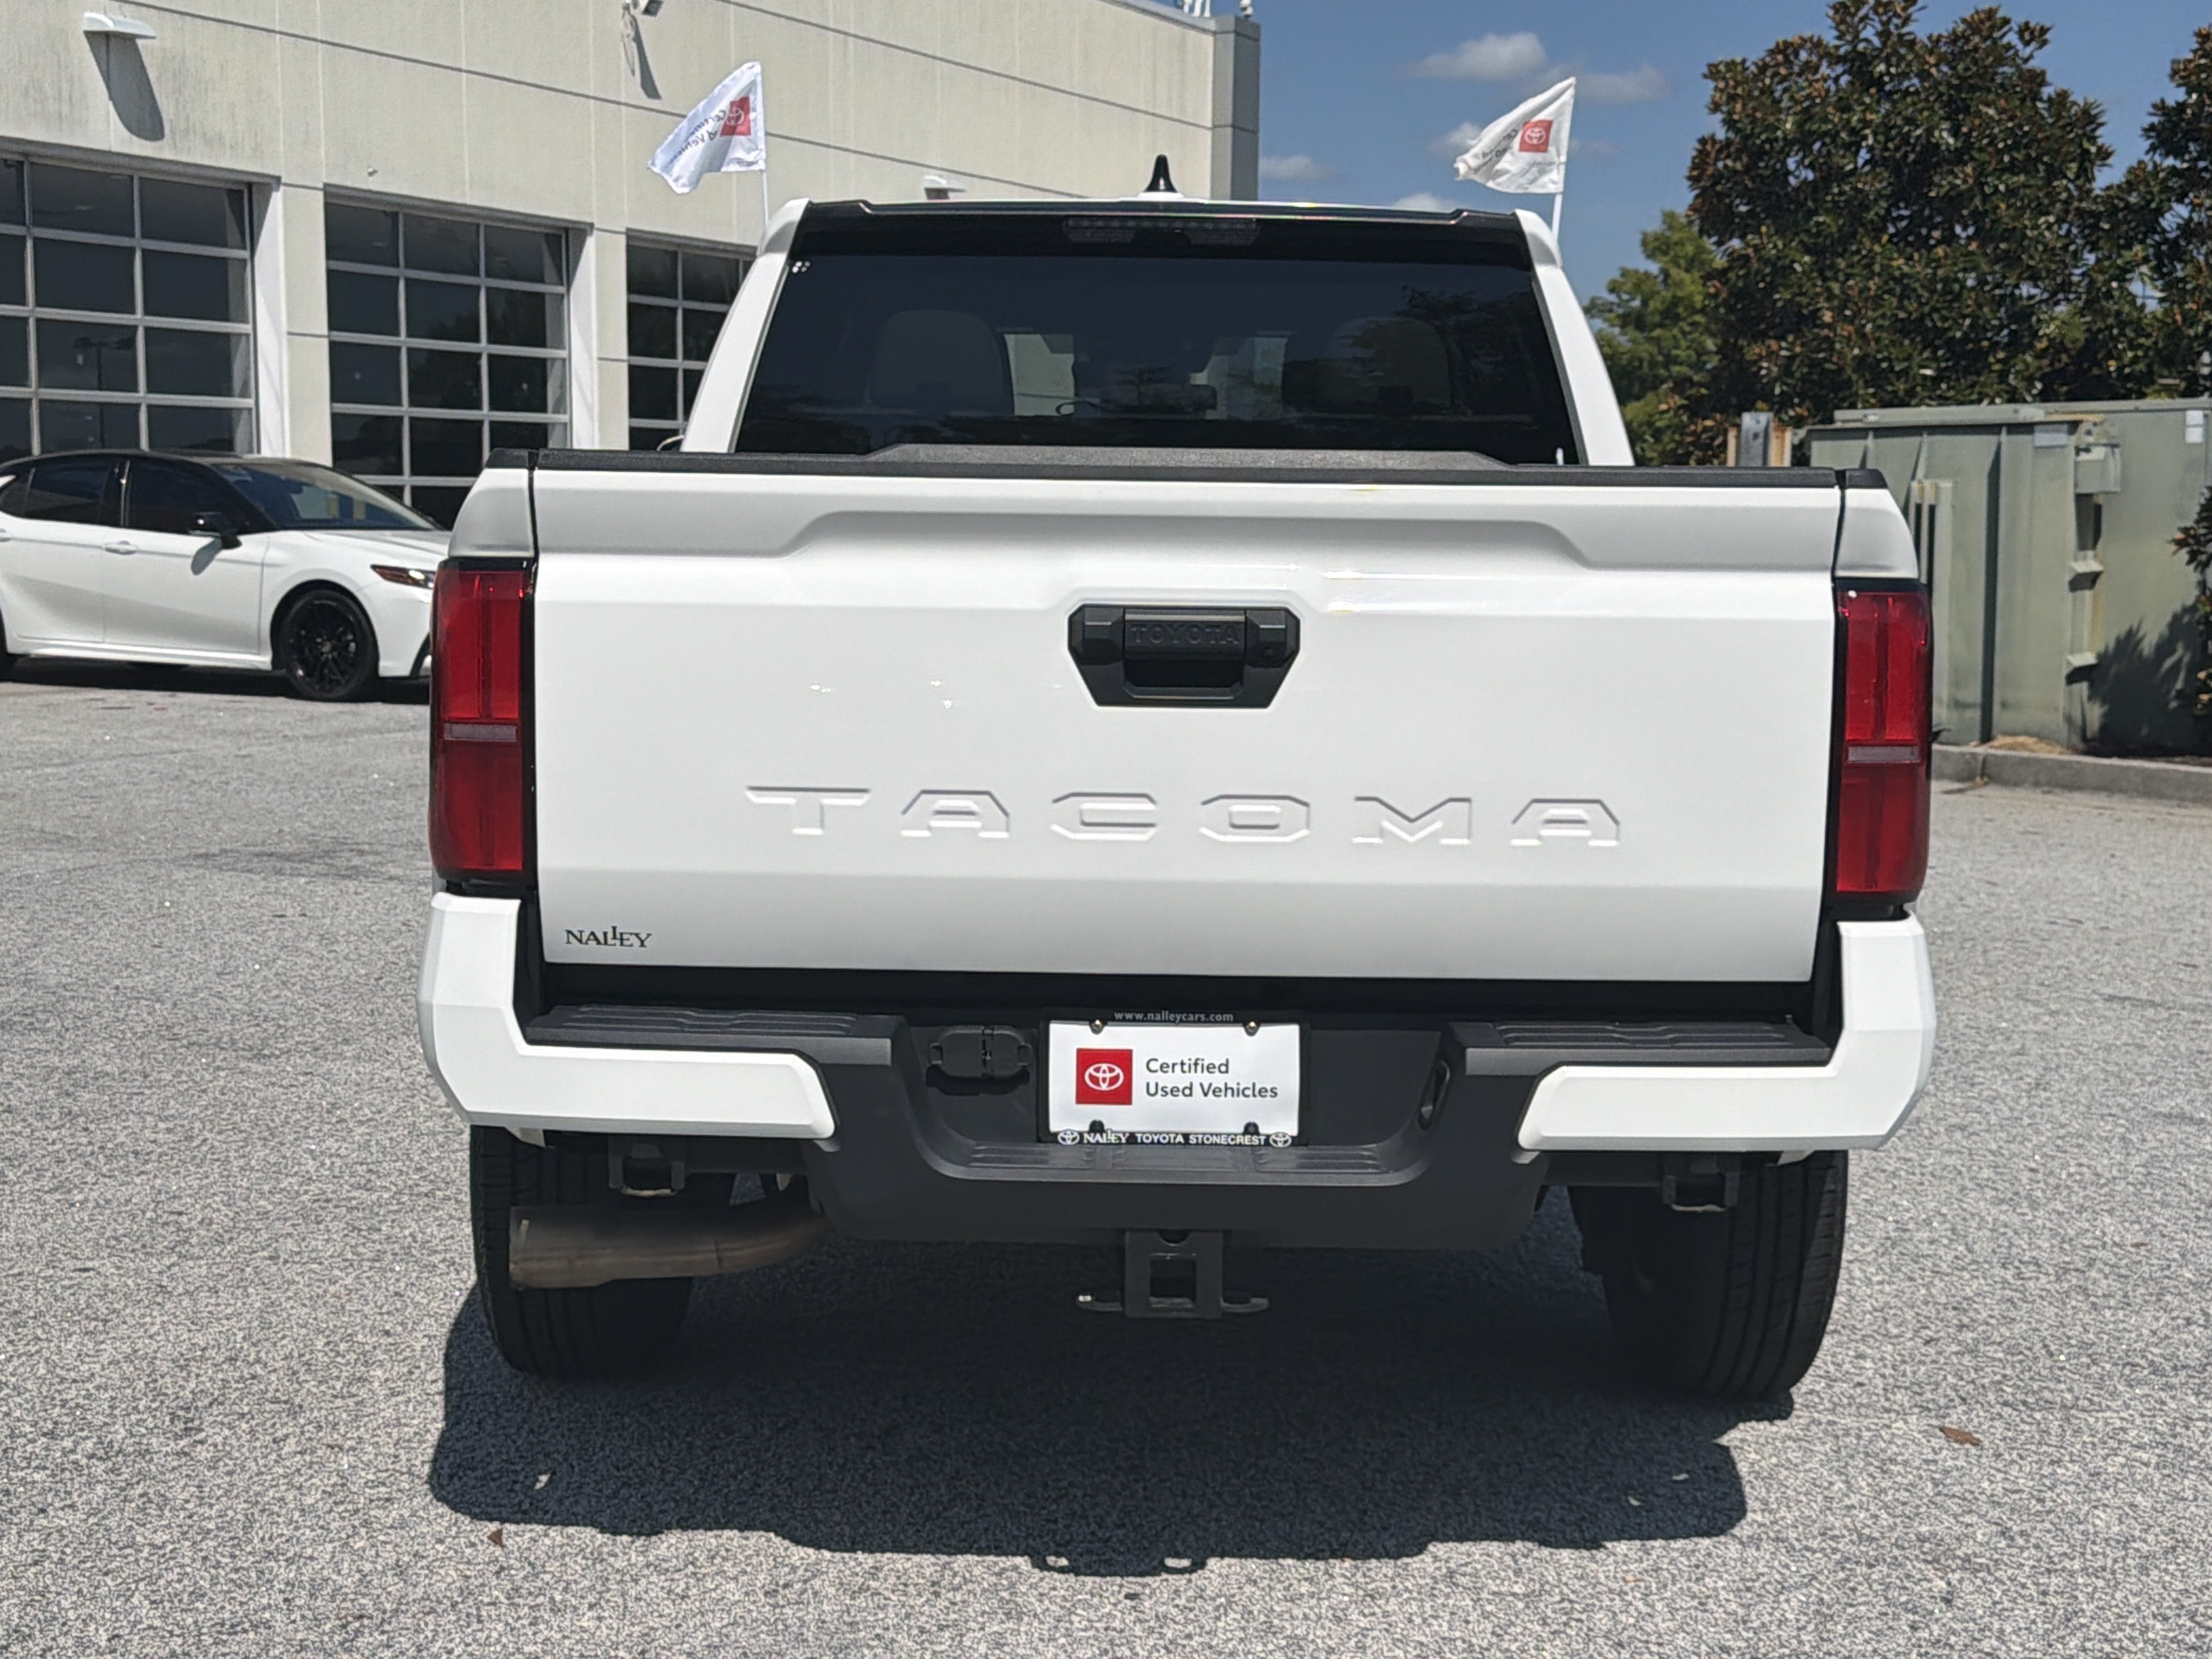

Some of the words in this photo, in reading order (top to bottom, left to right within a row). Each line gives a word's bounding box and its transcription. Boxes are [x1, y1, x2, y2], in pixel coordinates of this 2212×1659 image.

[1130, 624, 1239, 644] TOYOTA
[746, 787, 1622, 846] TACOMA
[565, 926, 652, 948] NALLEY
[1114, 1011, 1234, 1024] www.nalleycars.com
[1146, 1058, 1229, 1075] Certified
[1146, 1081, 1193, 1098] Used
[1199, 1082, 1278, 1099] Vehicles
[1083, 1129, 1130, 1144] NALLEY
[1136, 1133, 1185, 1144] TOYOTA
[1189, 1134, 1266, 1146] STONECREST
